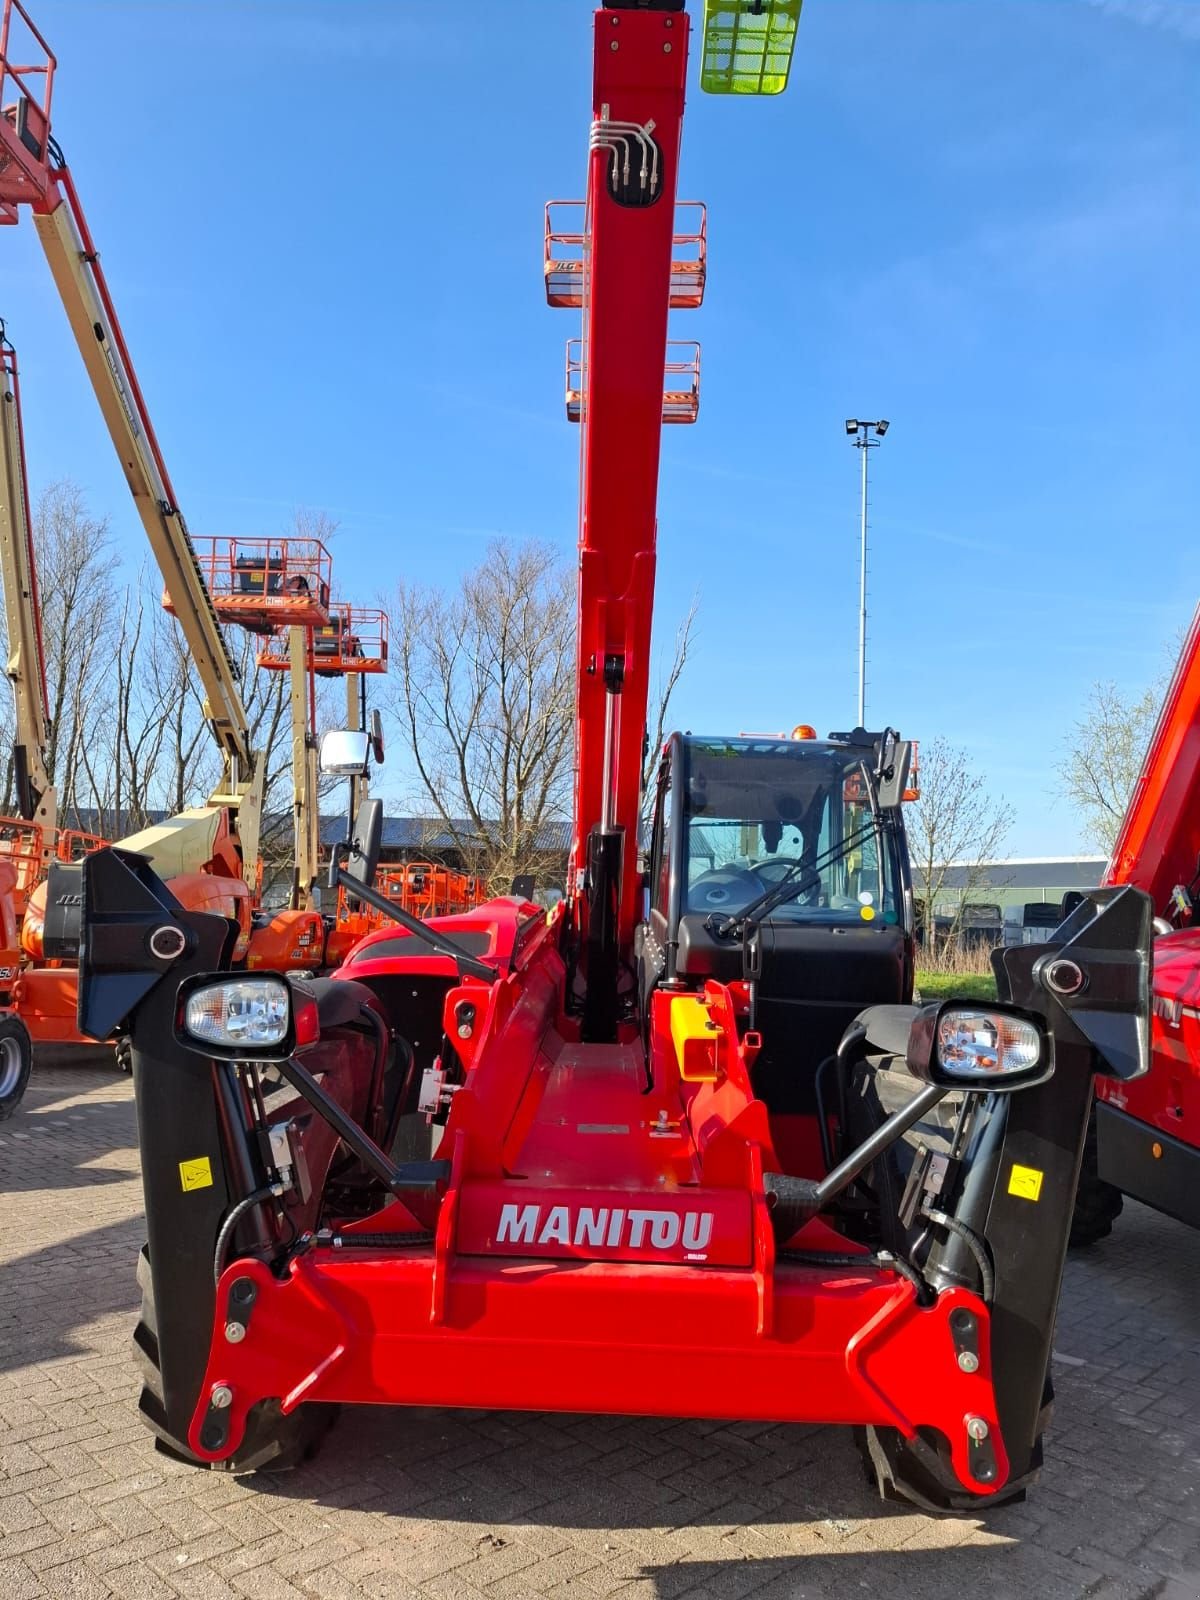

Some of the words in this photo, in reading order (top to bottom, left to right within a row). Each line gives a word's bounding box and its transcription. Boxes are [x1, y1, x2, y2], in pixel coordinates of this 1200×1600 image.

[556, 262, 575, 270] JLG
[56, 894, 81, 905] JLG
[495, 1204, 714, 1250] MANITOU
